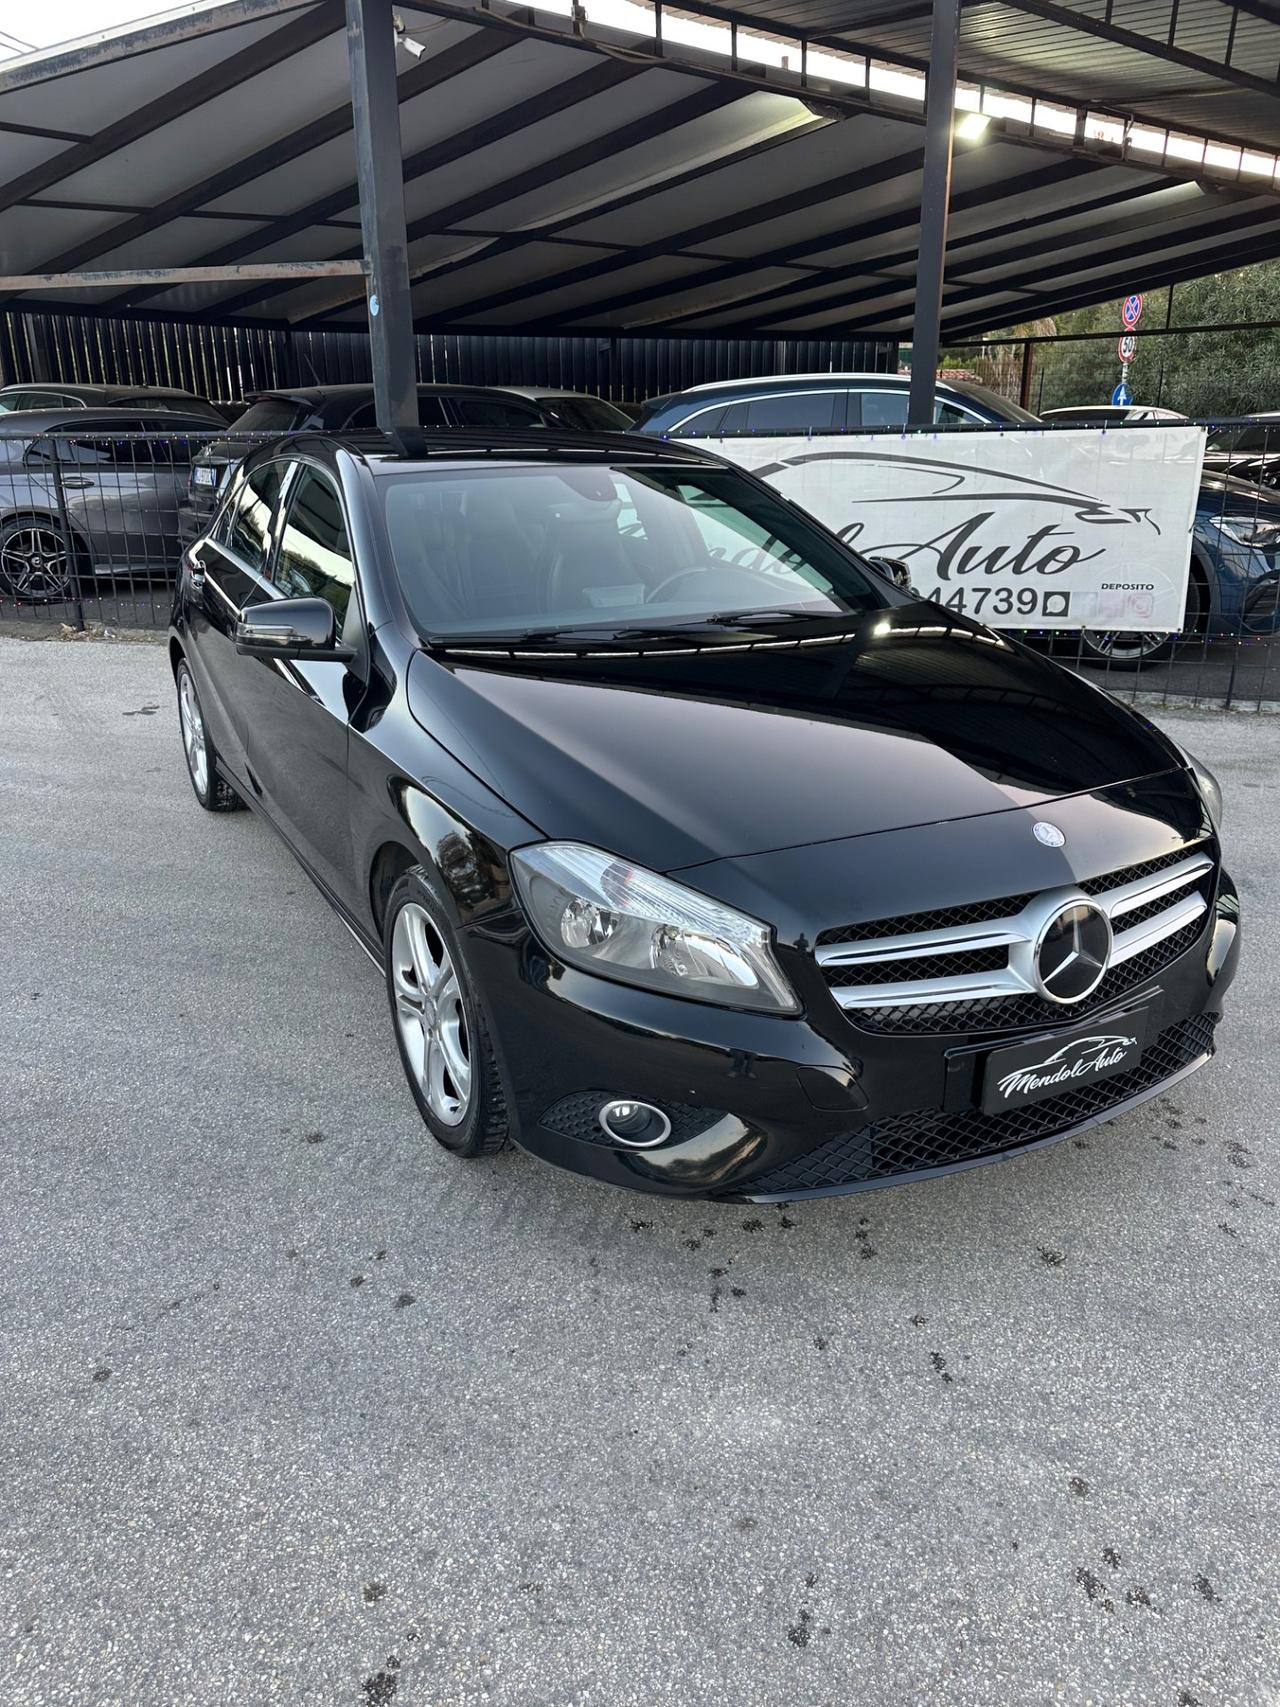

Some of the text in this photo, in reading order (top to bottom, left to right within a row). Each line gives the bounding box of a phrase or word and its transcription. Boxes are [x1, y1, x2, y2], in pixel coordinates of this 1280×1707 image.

[1123, 336, 1133, 353] 50
[1101, 583, 1154, 591] DEPOSITO
[911, 586, 1038, 615] 44739
